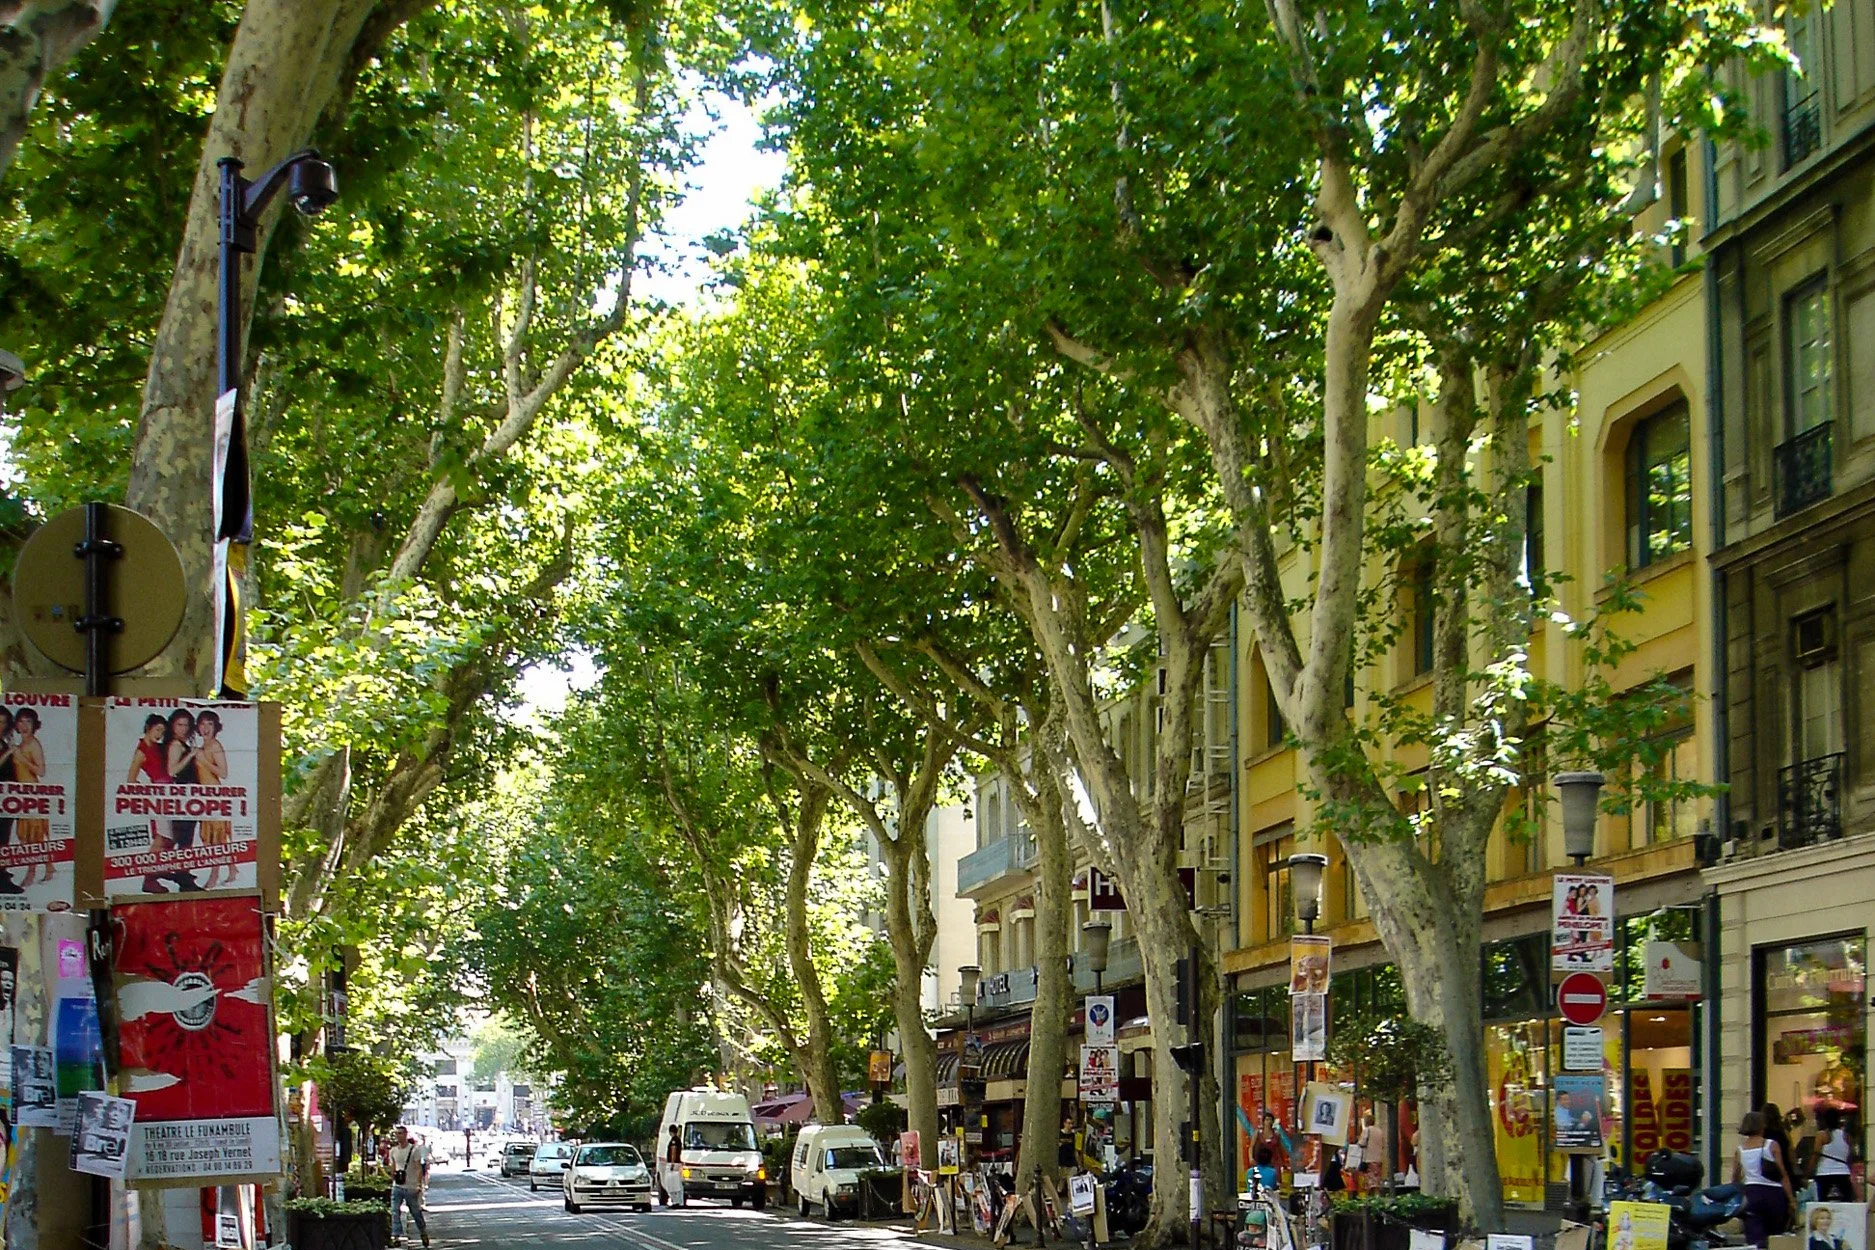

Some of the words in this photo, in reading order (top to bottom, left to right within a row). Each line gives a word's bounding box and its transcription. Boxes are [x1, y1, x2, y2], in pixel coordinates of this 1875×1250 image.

[5, 692, 71, 707] LOUVRE
[169, 786, 187, 797] DE
[190, 787, 247, 797] PLEURER
[115, 798, 232, 816] PENELOPE
[0, 840, 66, 857] CTATEURS
[111, 857, 131, 868] 300
[135, 853, 157, 865] 000
[160, 841, 249, 862] SPECTATEURS
[1665, 1074, 1690, 1151] OLDES
[185, 1124, 194, 1137] LE
[198, 1122, 251, 1137] FUNAMBULE
[170, 1150, 185, 1160] rue
[188, 1148, 220, 1161] Joseph
[224, 1147, 252, 1158] Vernet
